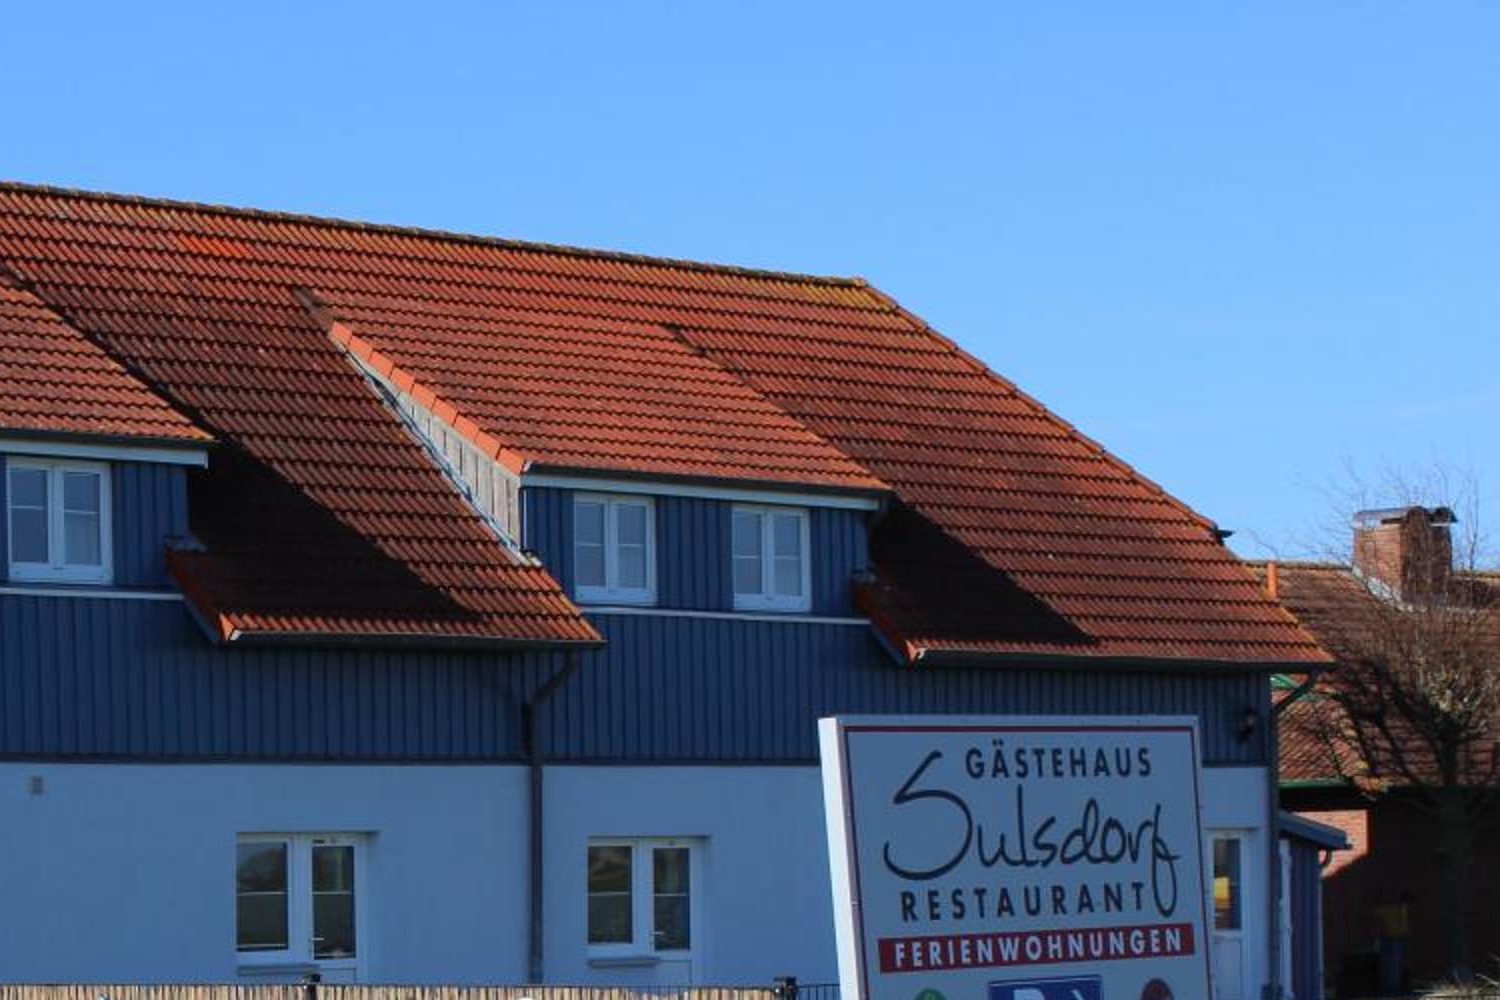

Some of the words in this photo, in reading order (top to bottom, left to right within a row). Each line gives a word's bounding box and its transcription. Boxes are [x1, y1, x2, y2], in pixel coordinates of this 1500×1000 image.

[965, 739, 1151, 779] GÄSTEHAUS
[883, 750, 1181, 918] Sulsdorf
[900, 881, 1145, 923] RESTAURANT
[894, 927, 1182, 969] FERIENWOHNUNGEN
